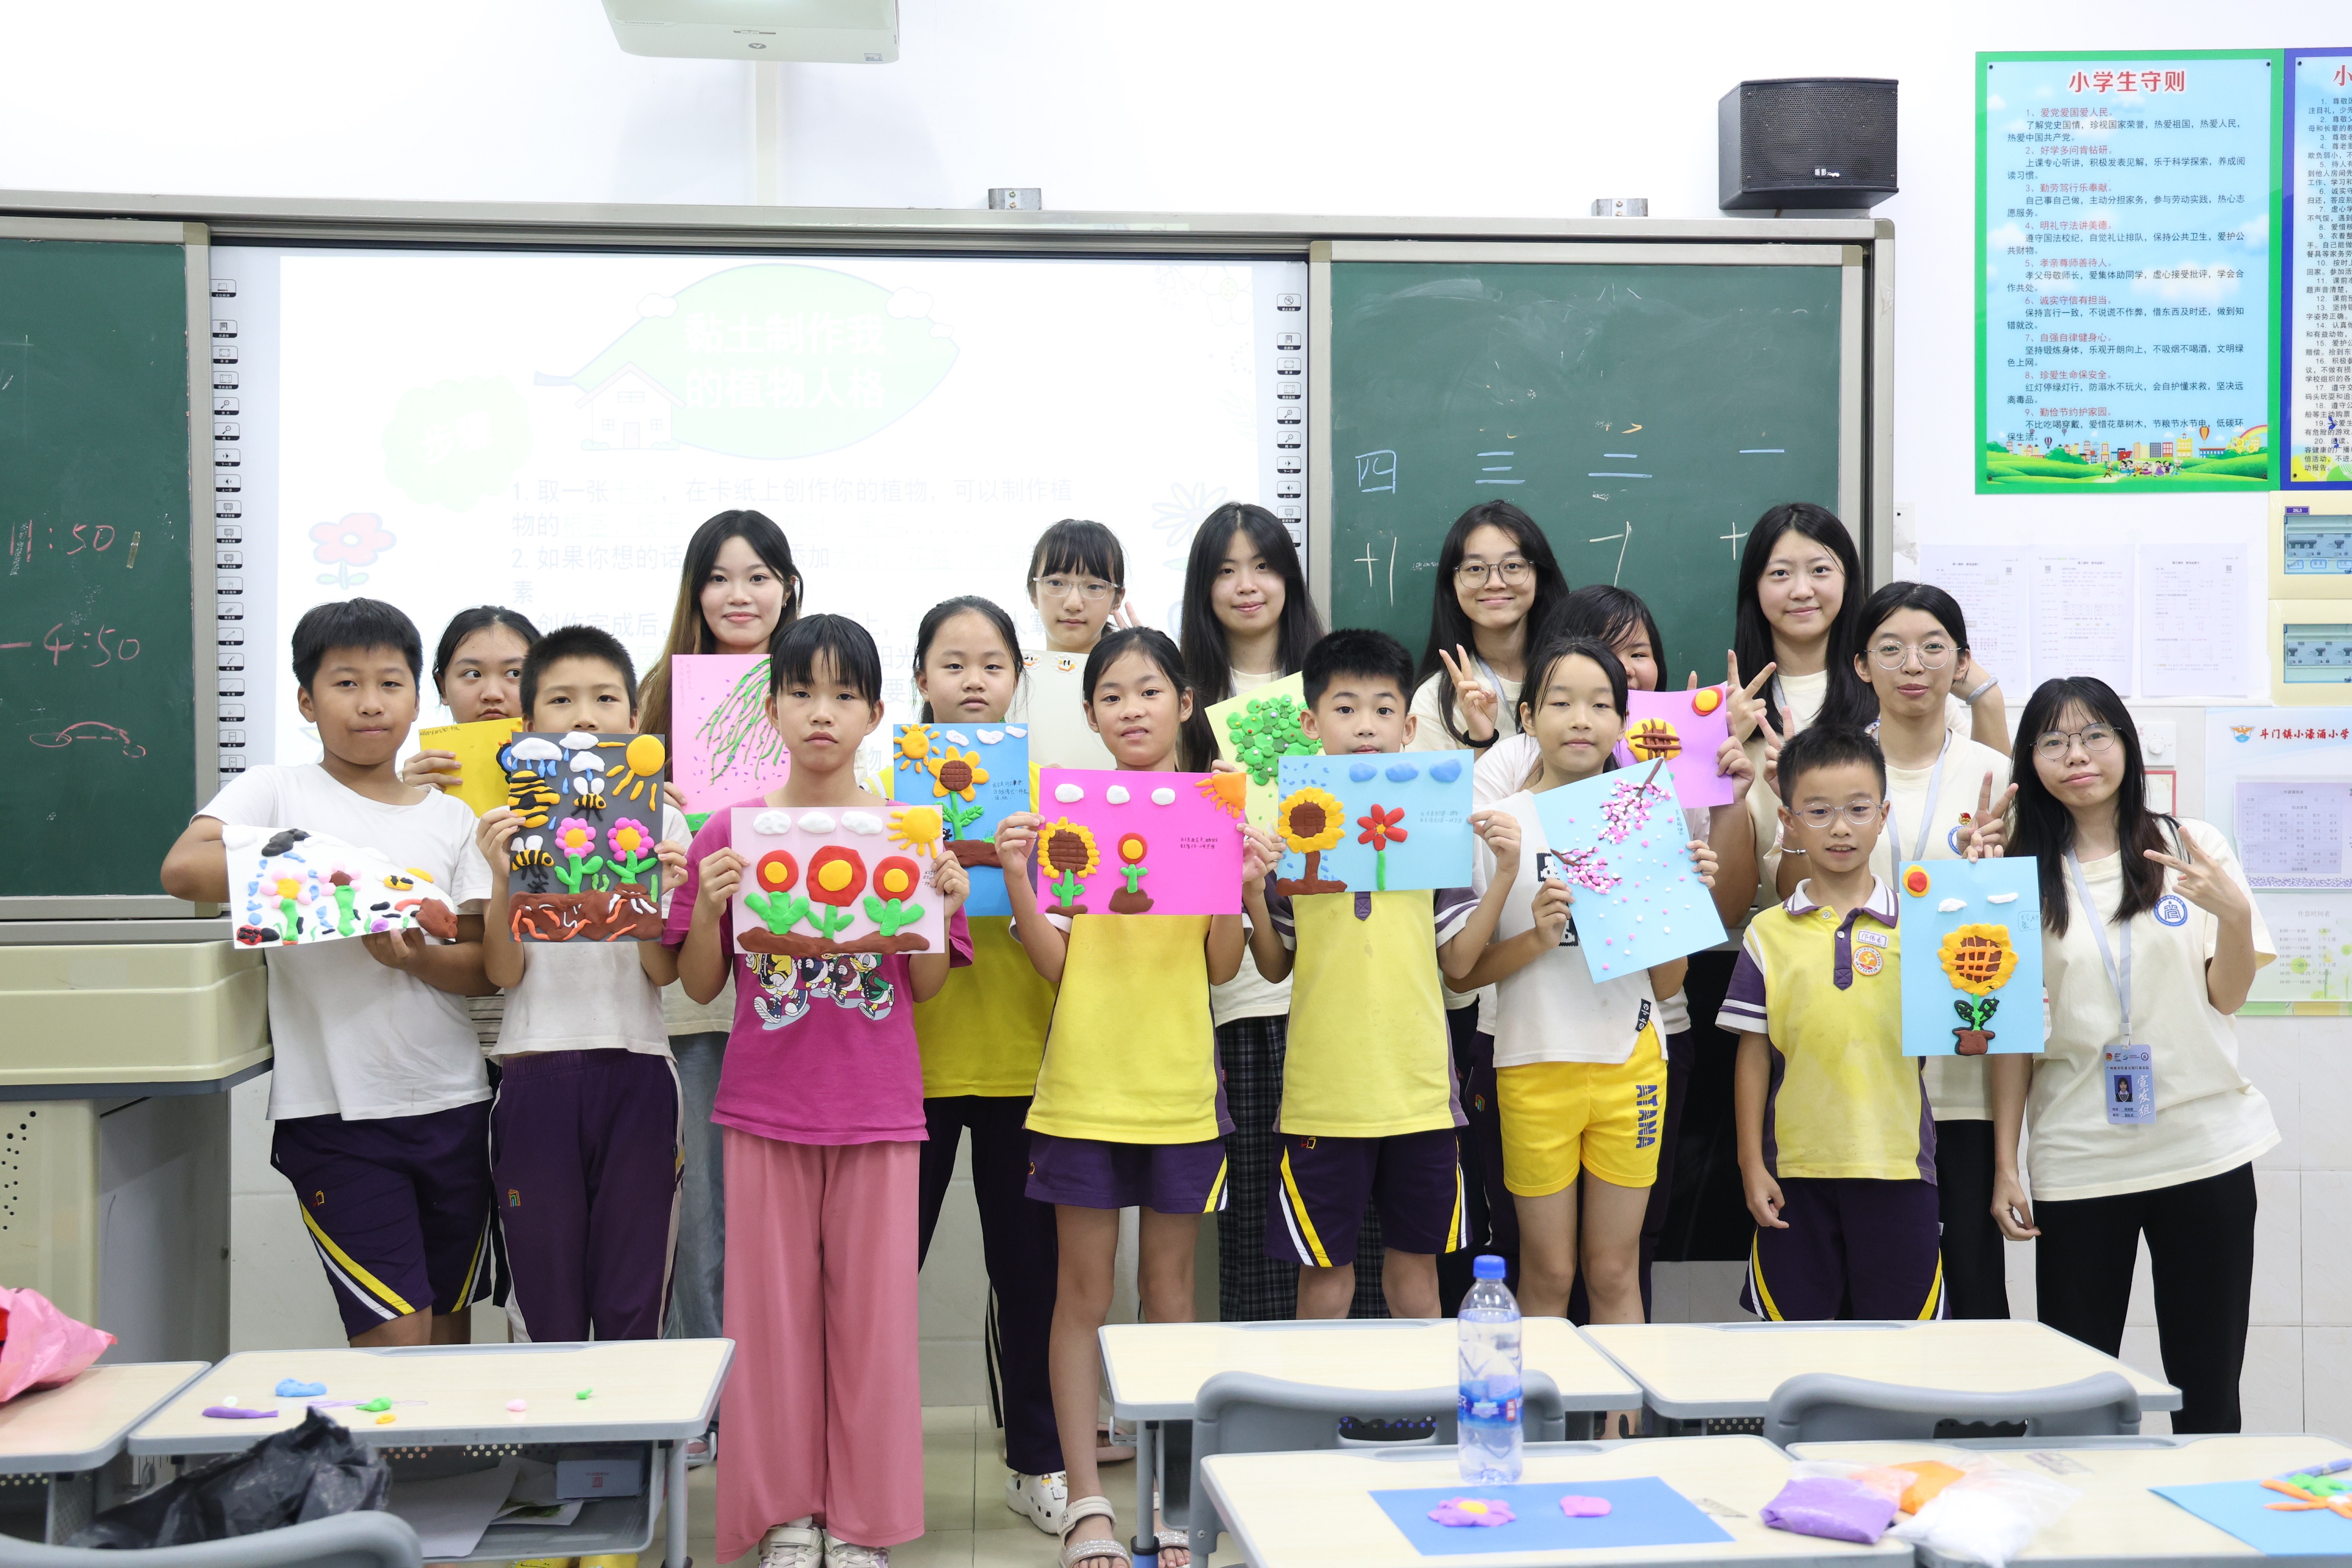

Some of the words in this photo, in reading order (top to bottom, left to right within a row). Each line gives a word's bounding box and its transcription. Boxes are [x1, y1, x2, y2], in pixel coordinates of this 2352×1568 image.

[2333, 65, 2352, 87] 小
[2069, 71, 2185, 93] 小学生守则
[2026, 107, 2116, 118] 1、爱党爱国爱人民。
[2308, 106, 2352, 114] 注目礼，少先
[2007, 133, 2074, 143] 热爱中国共产党。
[2025, 145, 2112, 156] 2、好学多问肯钻研。
[2007, 170, 2038, 180] 读习惯。
[2308, 169, 2352, 177] 到他人房间先
[2025, 182, 2112, 193] 3、勤劳笃行乐奉献。
[2308, 196, 2352, 204] 归还，答应别
[2007, 208, 2038, 217] 愿服务。
[2307, 214, 2352, 222] 不气馁，遇到
[2023, 219, 2111, 231] 4、明礼守法讲美德。
[2331, 223, 2352, 231] 爱惜粮
[2007, 246, 2038, 255] 共财物。
[2024, 257, 2112, 269] 5、孝亲尊师善待人。
[2007, 283, 2038, 293] 作共处。
[2306, 285, 2348, 294] 题声音清楚，
[2023, 295, 2111, 306] 6、诚实守信有担当。
[2007, 320, 2038, 330] 错就改。
[2023, 331, 2111, 343] 7、自强自律健身心。
[2007, 358, 2038, 367] 色上网。
[2024, 370, 2111, 381] 8、珍爱生命保安全。
[2007, 395, 2037, 405] 离毒品。
[2023, 406, 2111, 418] 9、勤俭节约护家园。
[2305, 410, 2350, 420] 船等主动购票
[2007, 432, 2038, 443] 保生活。
[2304, 445, 2352, 455] 容健康的广播
[2303, 454, 2352, 464] 信活动，不进
[1355, 449, 1396, 493] 四
[1475, 451, 1525, 483] 三
[1588, 453, 1652, 478] 二
[2304, 464, 2332, 472] 动报告。
[2259, 727, 2350, 741] 斗门镇小濠涌小学
[2137, 1074, 2152, 1118] 宣发组
[1635, 1085, 1659, 1149] ATANA
